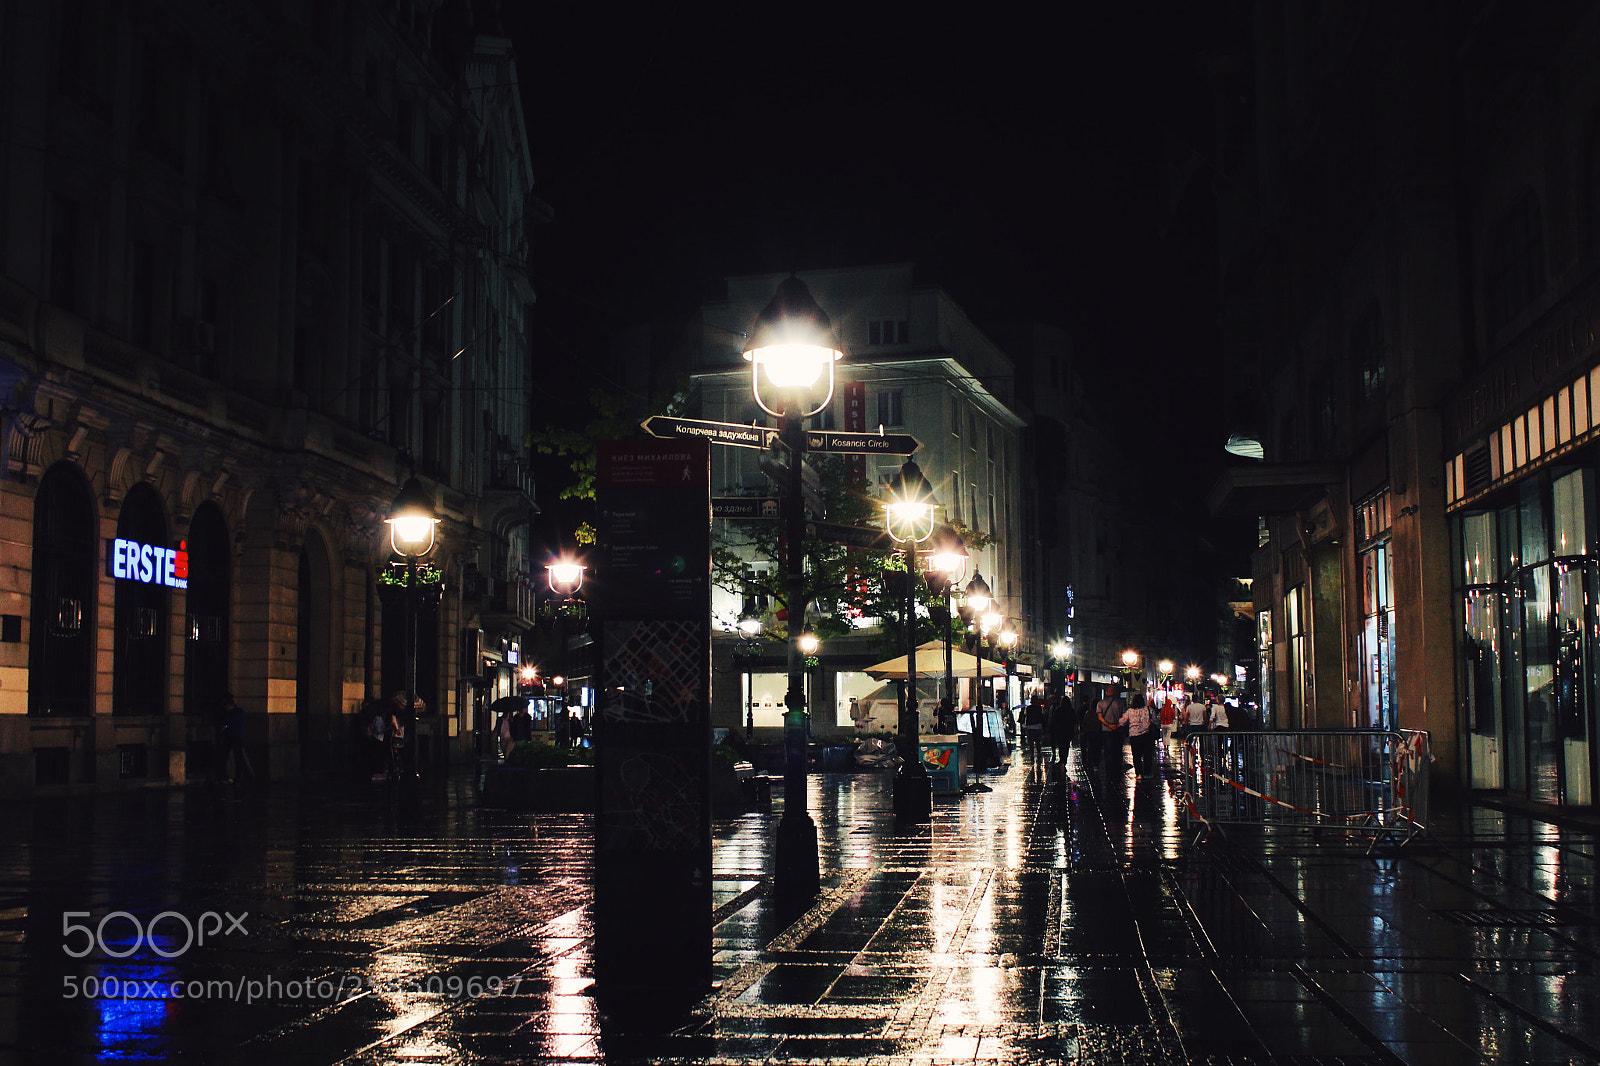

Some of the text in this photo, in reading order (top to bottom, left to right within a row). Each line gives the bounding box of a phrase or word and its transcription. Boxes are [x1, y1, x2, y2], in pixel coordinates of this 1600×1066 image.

[676, 424, 759, 442] Коларчева задужбина
[868, 439, 889, 448] Circle
[611, 454, 634, 462] КНЕЗ
[113, 538, 176, 587] ERSTE
